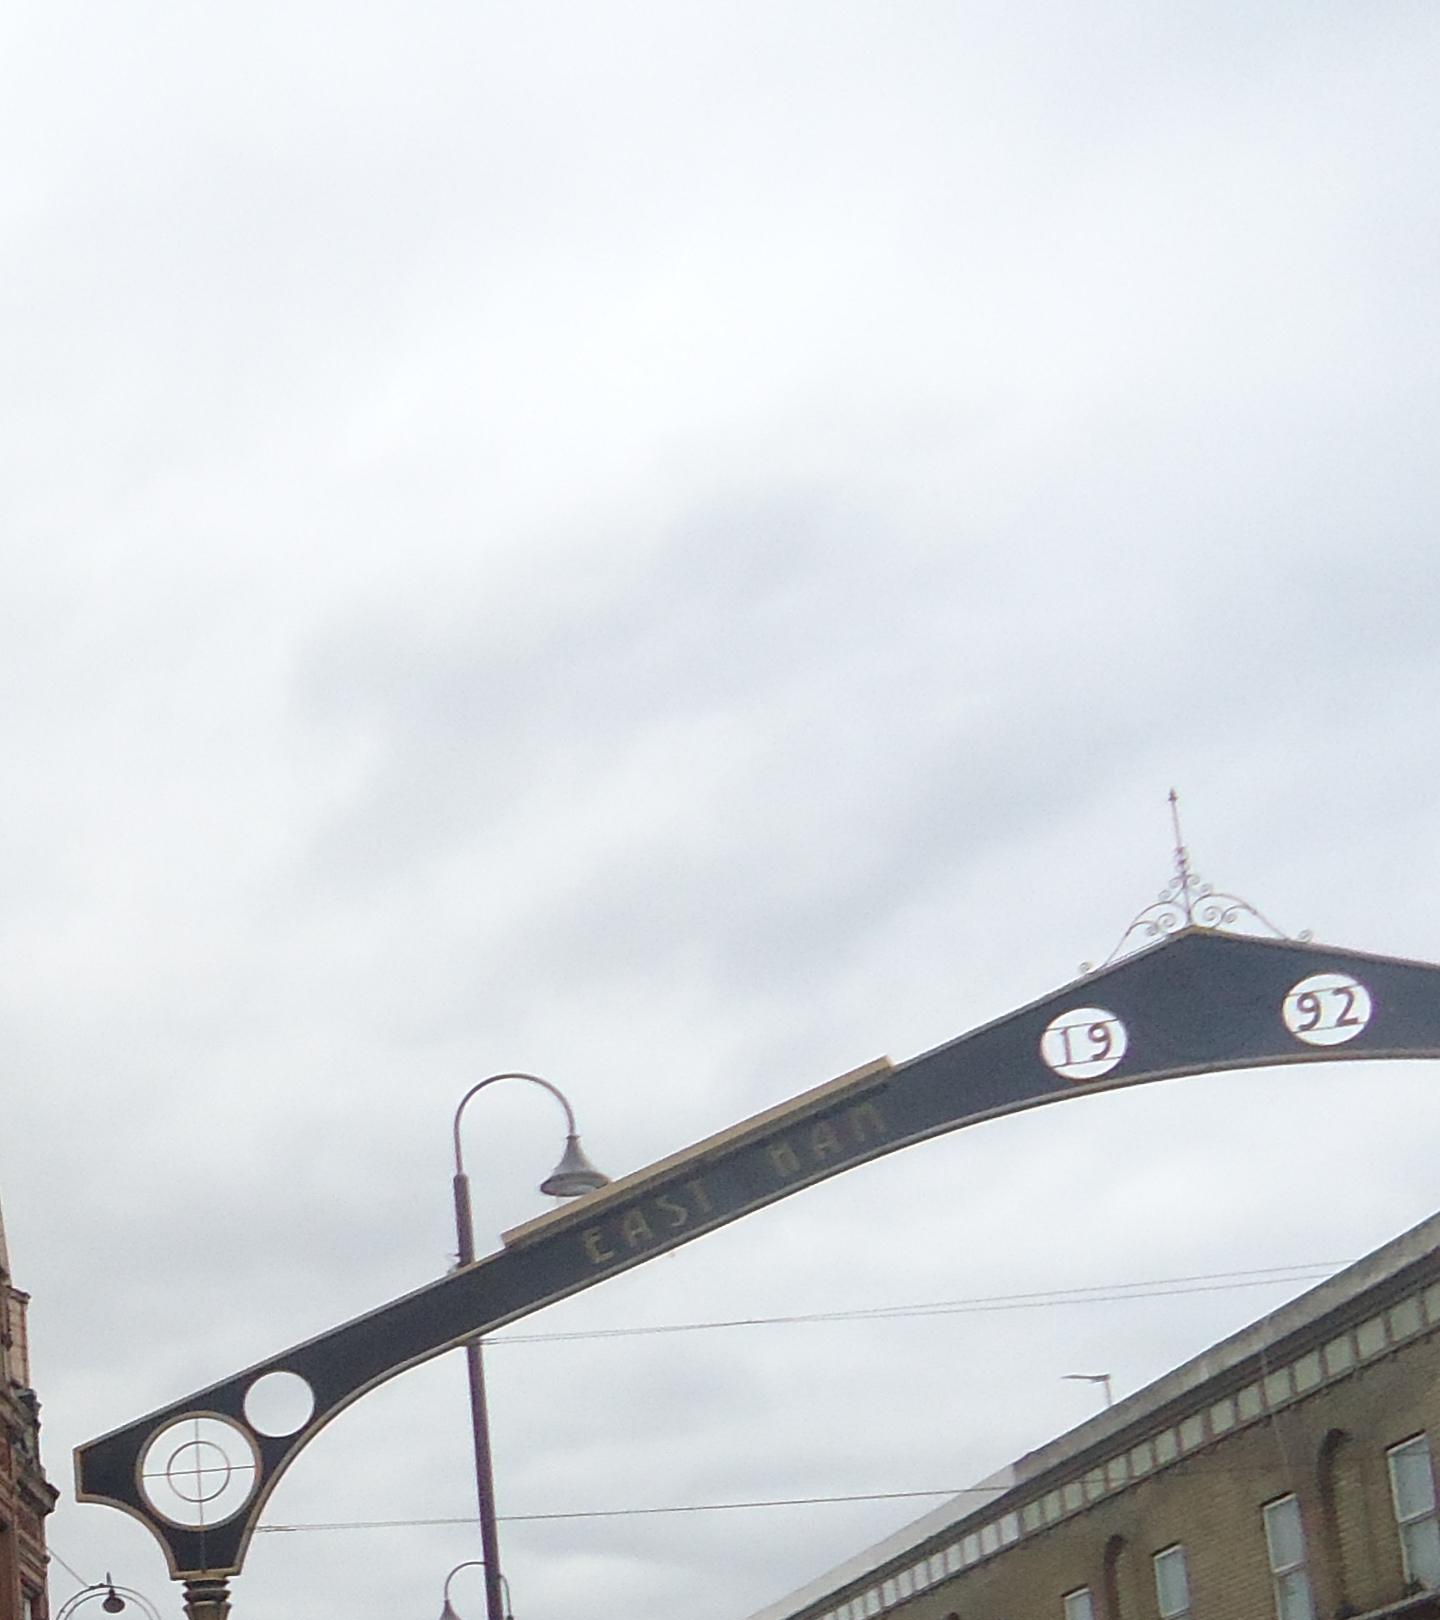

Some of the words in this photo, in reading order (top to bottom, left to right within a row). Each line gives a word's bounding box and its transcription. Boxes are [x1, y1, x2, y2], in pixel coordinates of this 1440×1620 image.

[1060, 1022, 1113, 1065] 19
[1296, 987, 1360, 1032] 92
[581, 1179, 714, 1264] EAST
